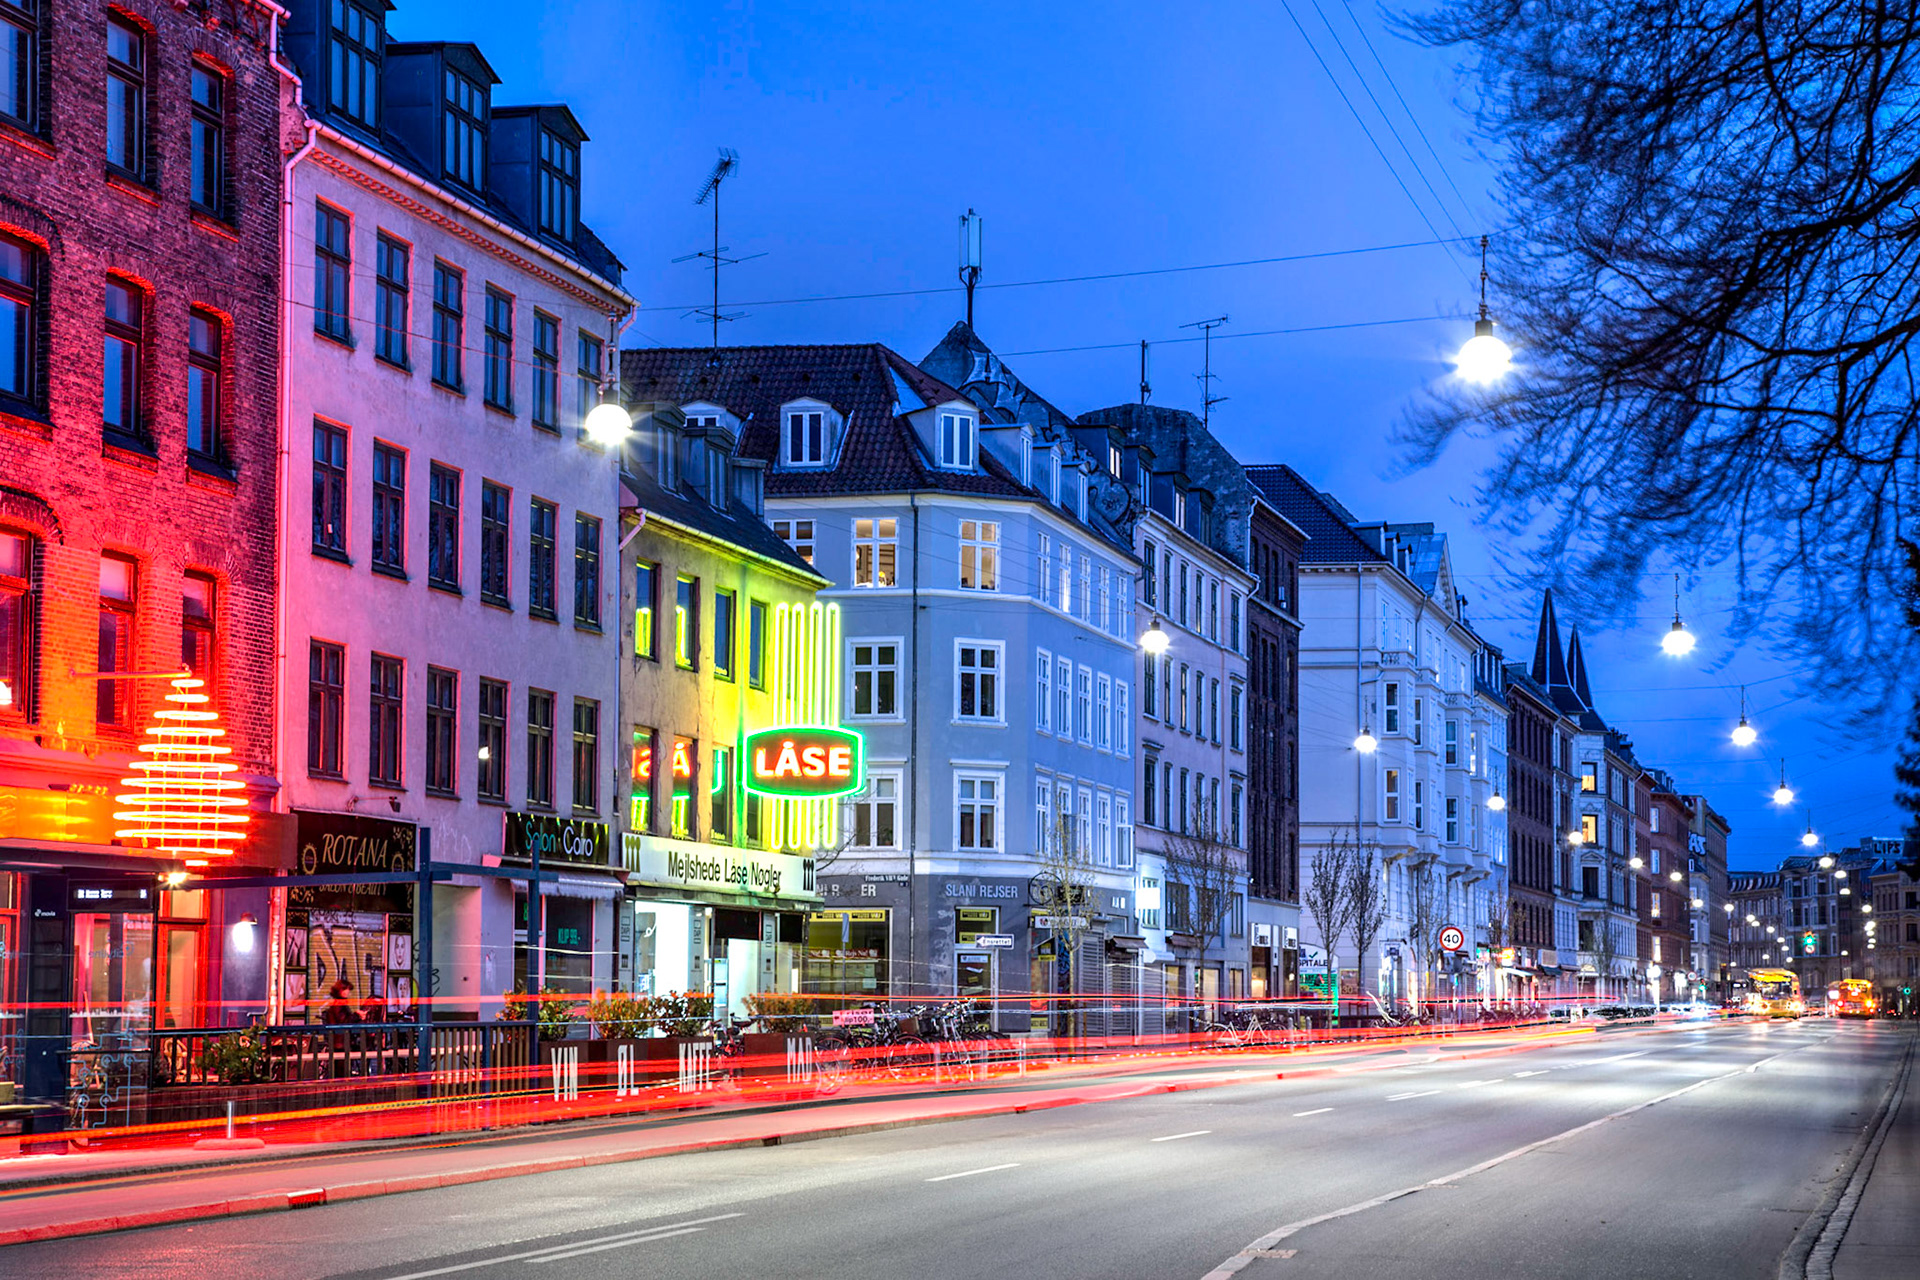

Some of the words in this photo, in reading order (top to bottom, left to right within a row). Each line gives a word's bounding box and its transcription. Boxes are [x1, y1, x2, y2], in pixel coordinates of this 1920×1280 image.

[755, 741, 851, 778] LÅSE
[322, 833, 388, 868] ROTANA
[1874, 841, 1901, 854] LIPS
[668, 851, 721, 884] Mejlshede
[725, 858, 748, 885] Låse
[945, 883, 976, 897] SLANI
[980, 884, 1018, 898] REJSER
[1443, 934, 1460, 943] 40
[551, 1047, 578, 1102] VIN
[617, 1044, 639, 1096] ØL
[679, 1042, 712, 1093] KAFFE
[787, 1037, 812, 1084] MAD
